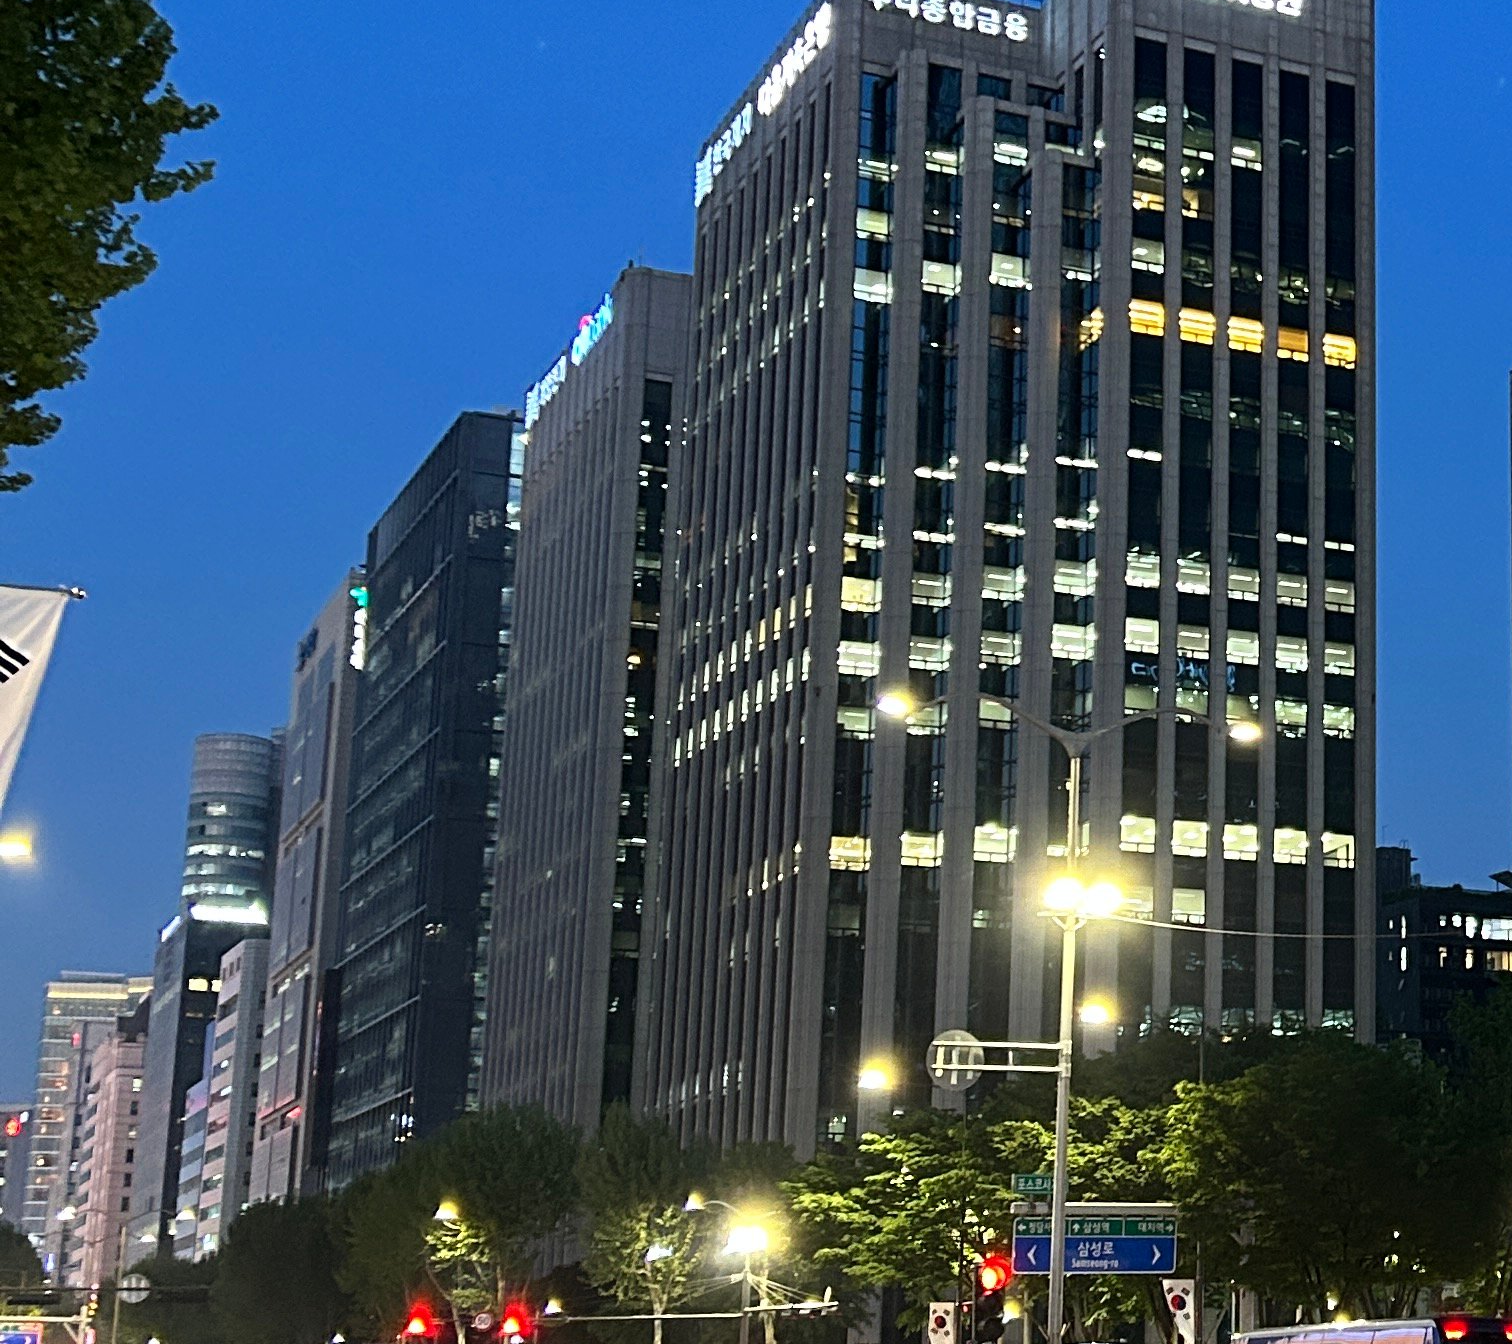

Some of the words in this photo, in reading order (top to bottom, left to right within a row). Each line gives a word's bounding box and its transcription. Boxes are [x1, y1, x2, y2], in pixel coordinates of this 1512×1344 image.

[1083, 1222, 1110, 1233] 삼성역
[1138, 1222, 1165, 1233] 대치역
[1077, 1241, 1115, 1257] 삼성로
[1071, 1258, 1119, 1270] Samseong-ro
